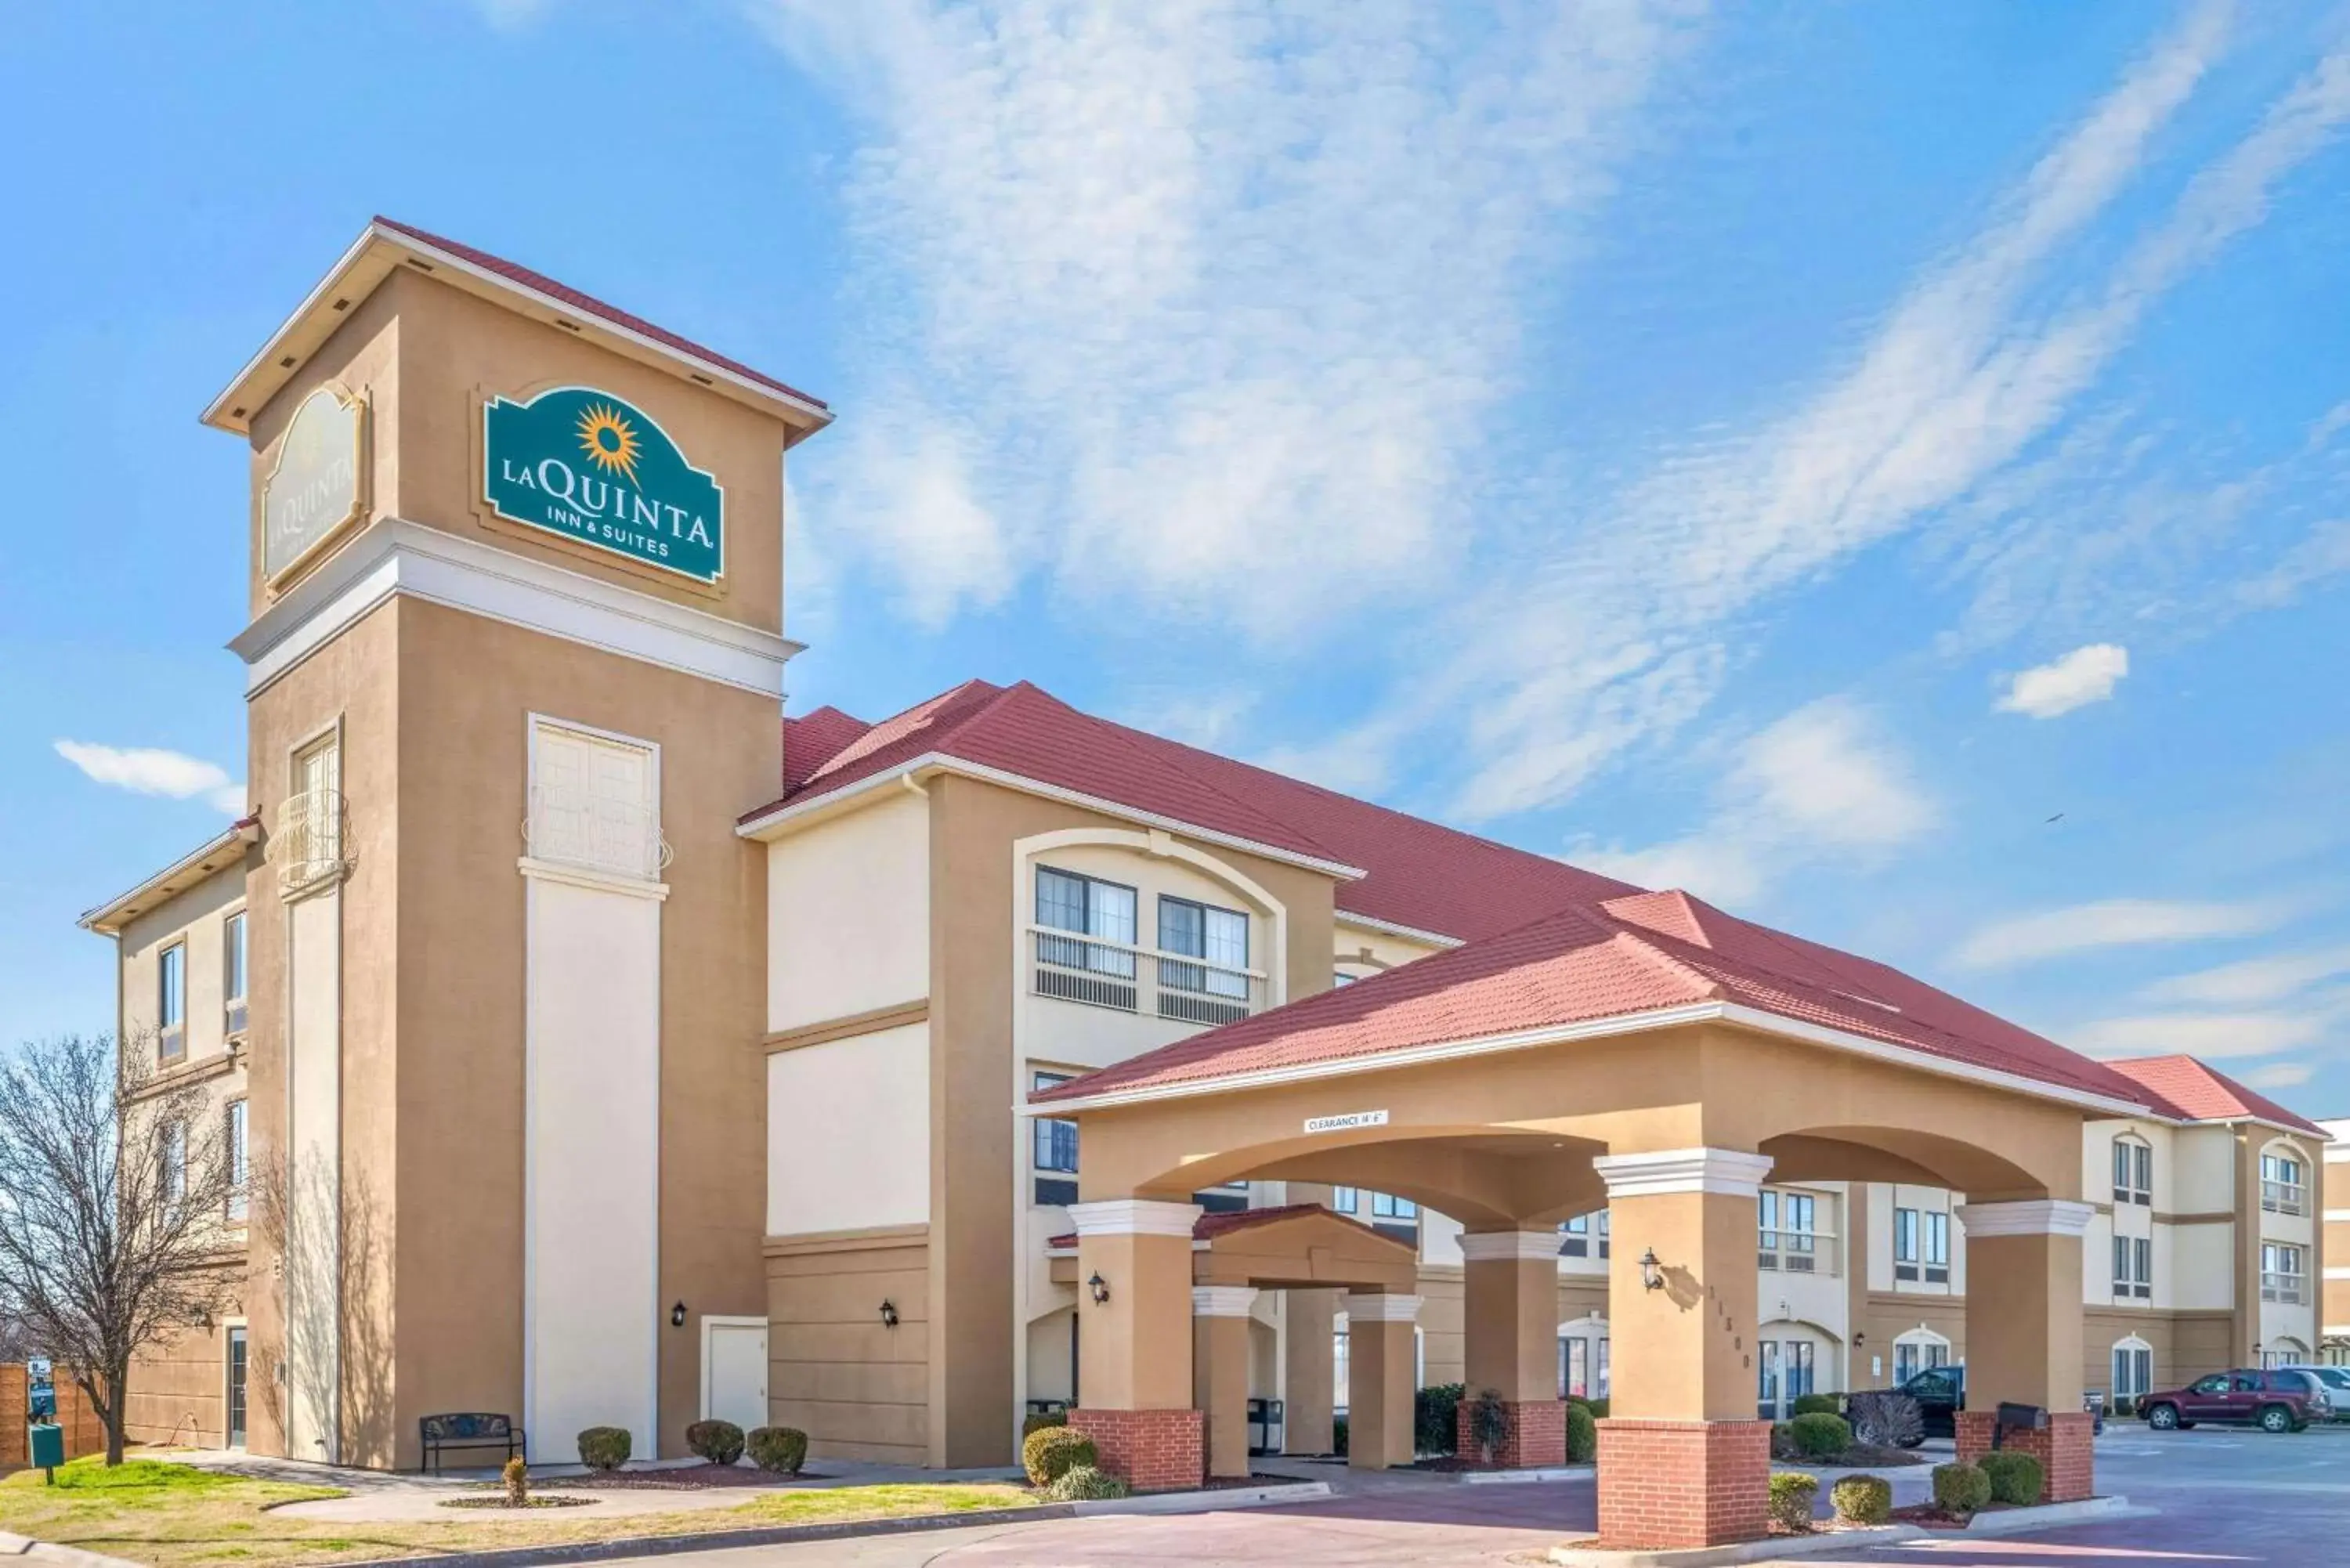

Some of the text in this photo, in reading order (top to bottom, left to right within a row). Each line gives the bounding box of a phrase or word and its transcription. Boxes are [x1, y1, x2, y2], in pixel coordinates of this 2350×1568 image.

[502, 459, 714, 548] LA QUINTA
[548, 506, 669, 557] INN & SUITES
[1309, 1117, 1358, 1129] CLEARANCE
